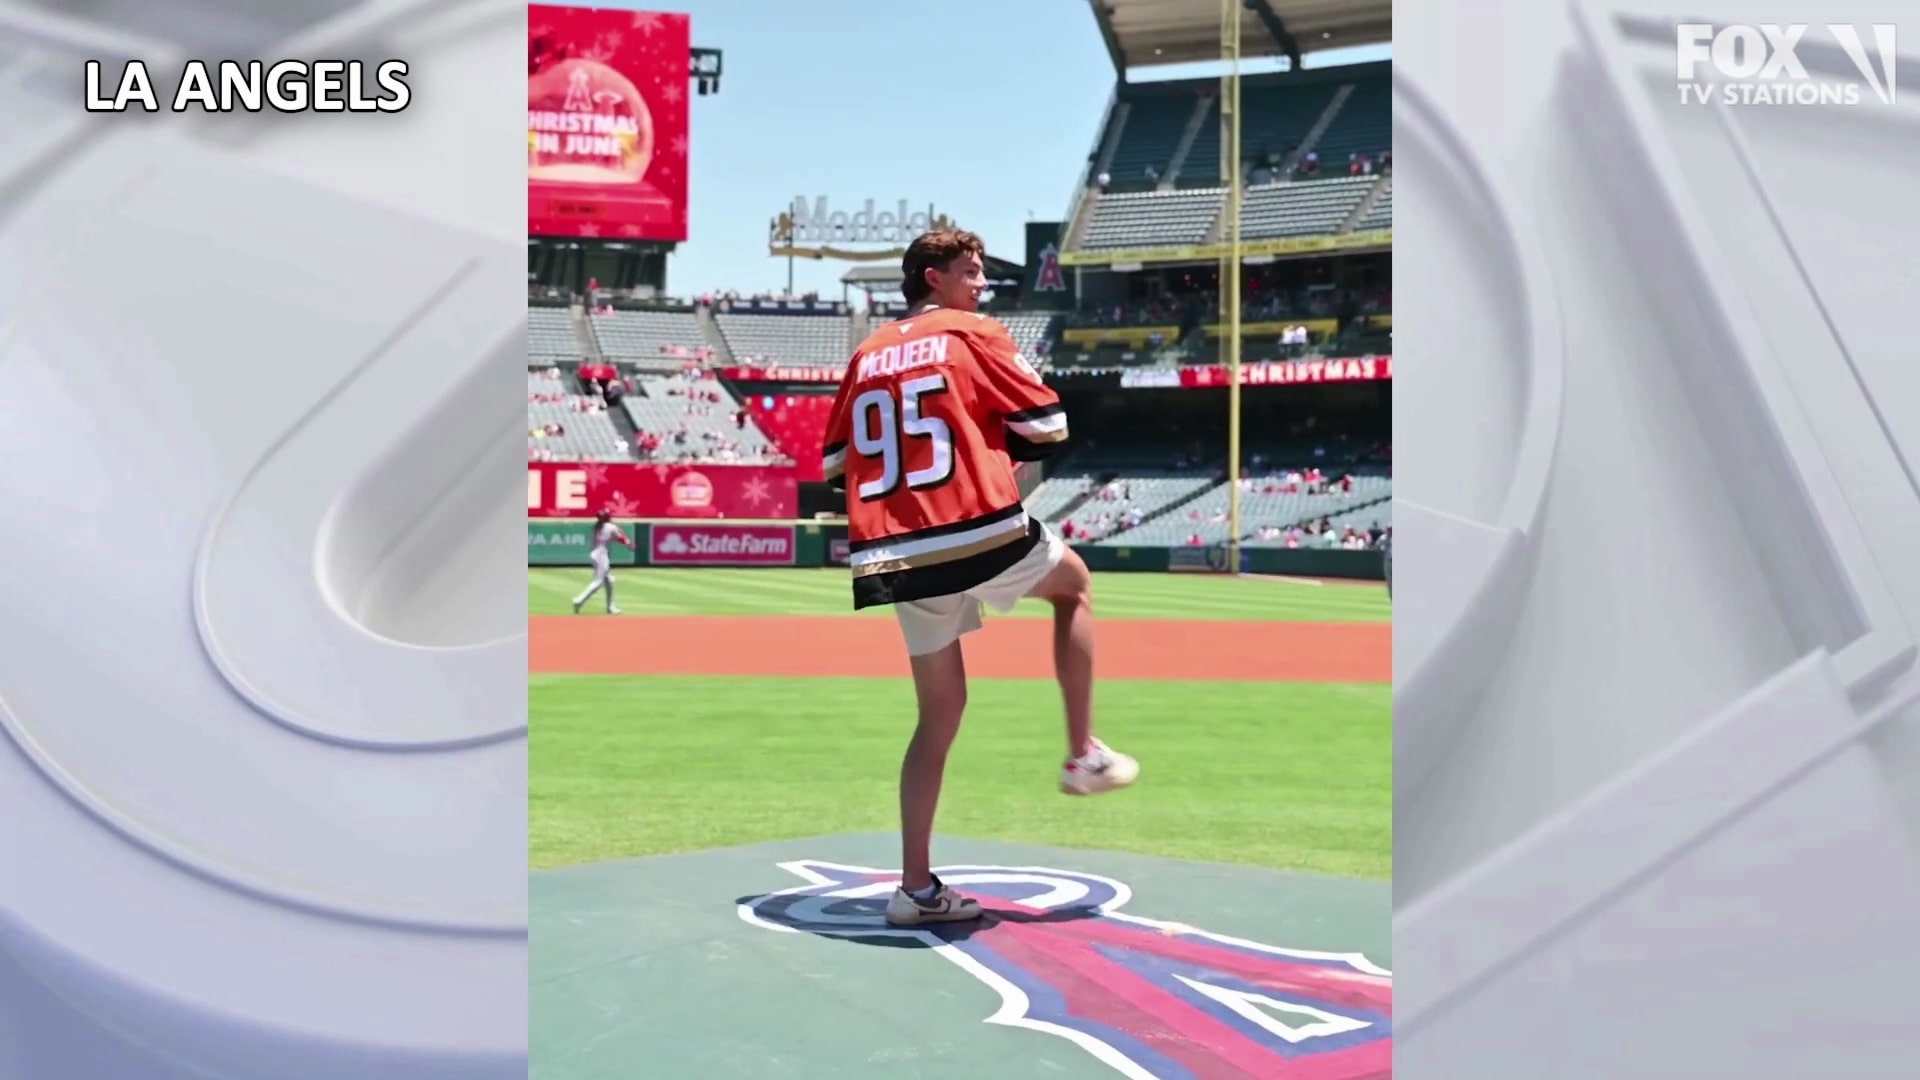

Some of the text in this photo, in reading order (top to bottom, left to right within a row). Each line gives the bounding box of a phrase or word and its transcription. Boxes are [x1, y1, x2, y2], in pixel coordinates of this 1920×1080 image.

[536, 132, 620, 156] IN JUNE
[793, 195, 931, 242] Modelo
[857, 336, 949, 384] McQUEEN
[853, 374, 956, 503] 95
